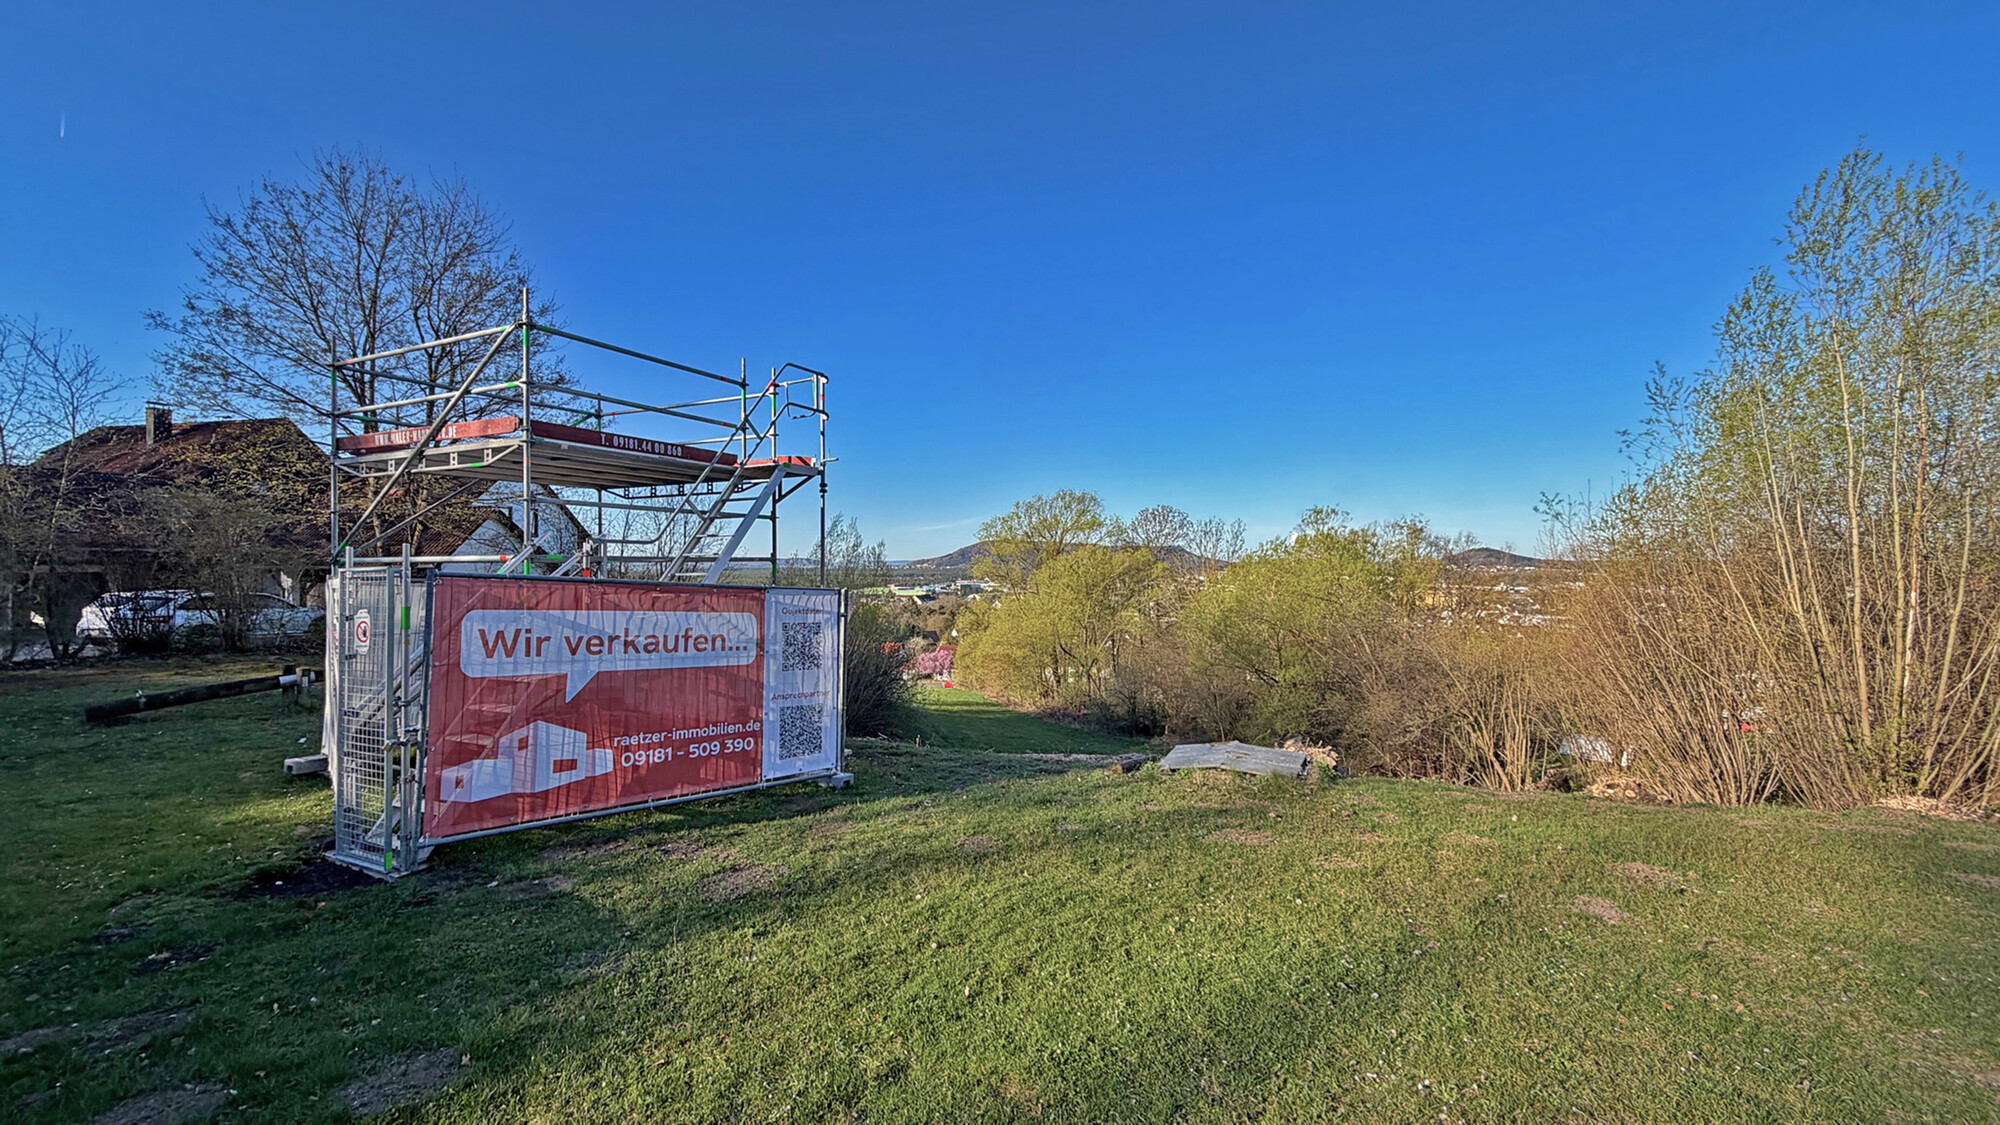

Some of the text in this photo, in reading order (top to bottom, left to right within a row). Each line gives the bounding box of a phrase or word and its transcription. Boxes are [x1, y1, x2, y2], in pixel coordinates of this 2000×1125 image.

[600, 434, 609, 446] T.
[478, 627, 748, 659] Wir verkaufen...
[771, 690, 830, 701] Ansprechpartner
[613, 720, 761, 747] raetzer-immobilien.de
[621, 747, 673, 767] 09181
[689, 741, 720, 758] 509
[724, 737, 754, 753] 390
